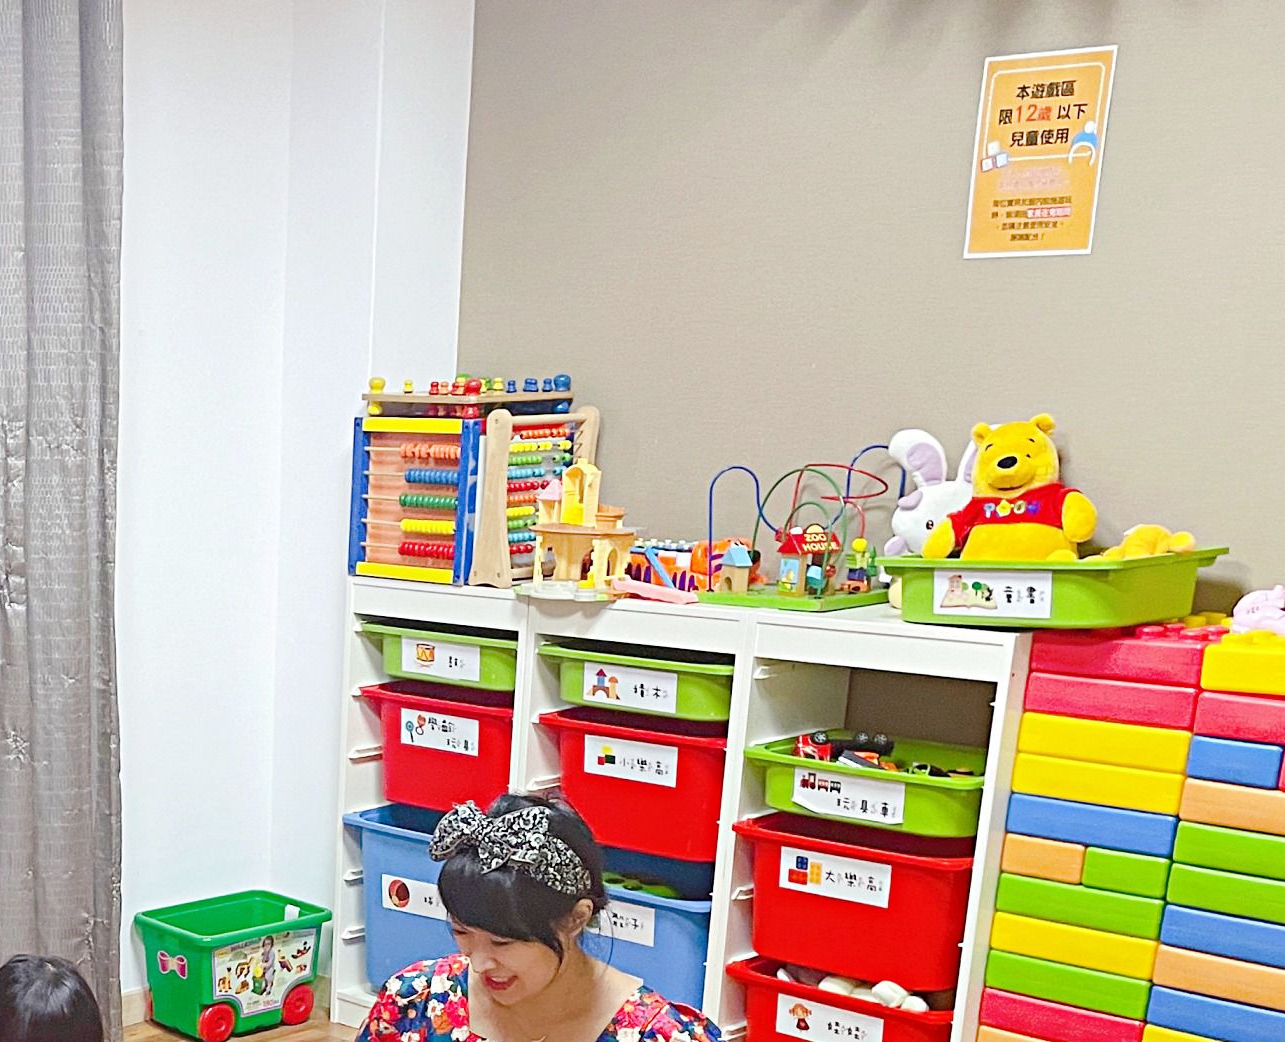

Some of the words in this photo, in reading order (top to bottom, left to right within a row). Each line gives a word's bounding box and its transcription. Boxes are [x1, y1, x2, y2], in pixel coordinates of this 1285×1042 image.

[1016, 80, 1076, 101] 本遊戲區
[1010, 128, 1070, 148] 兒童使用
[804, 533, 827, 542] ZOO
